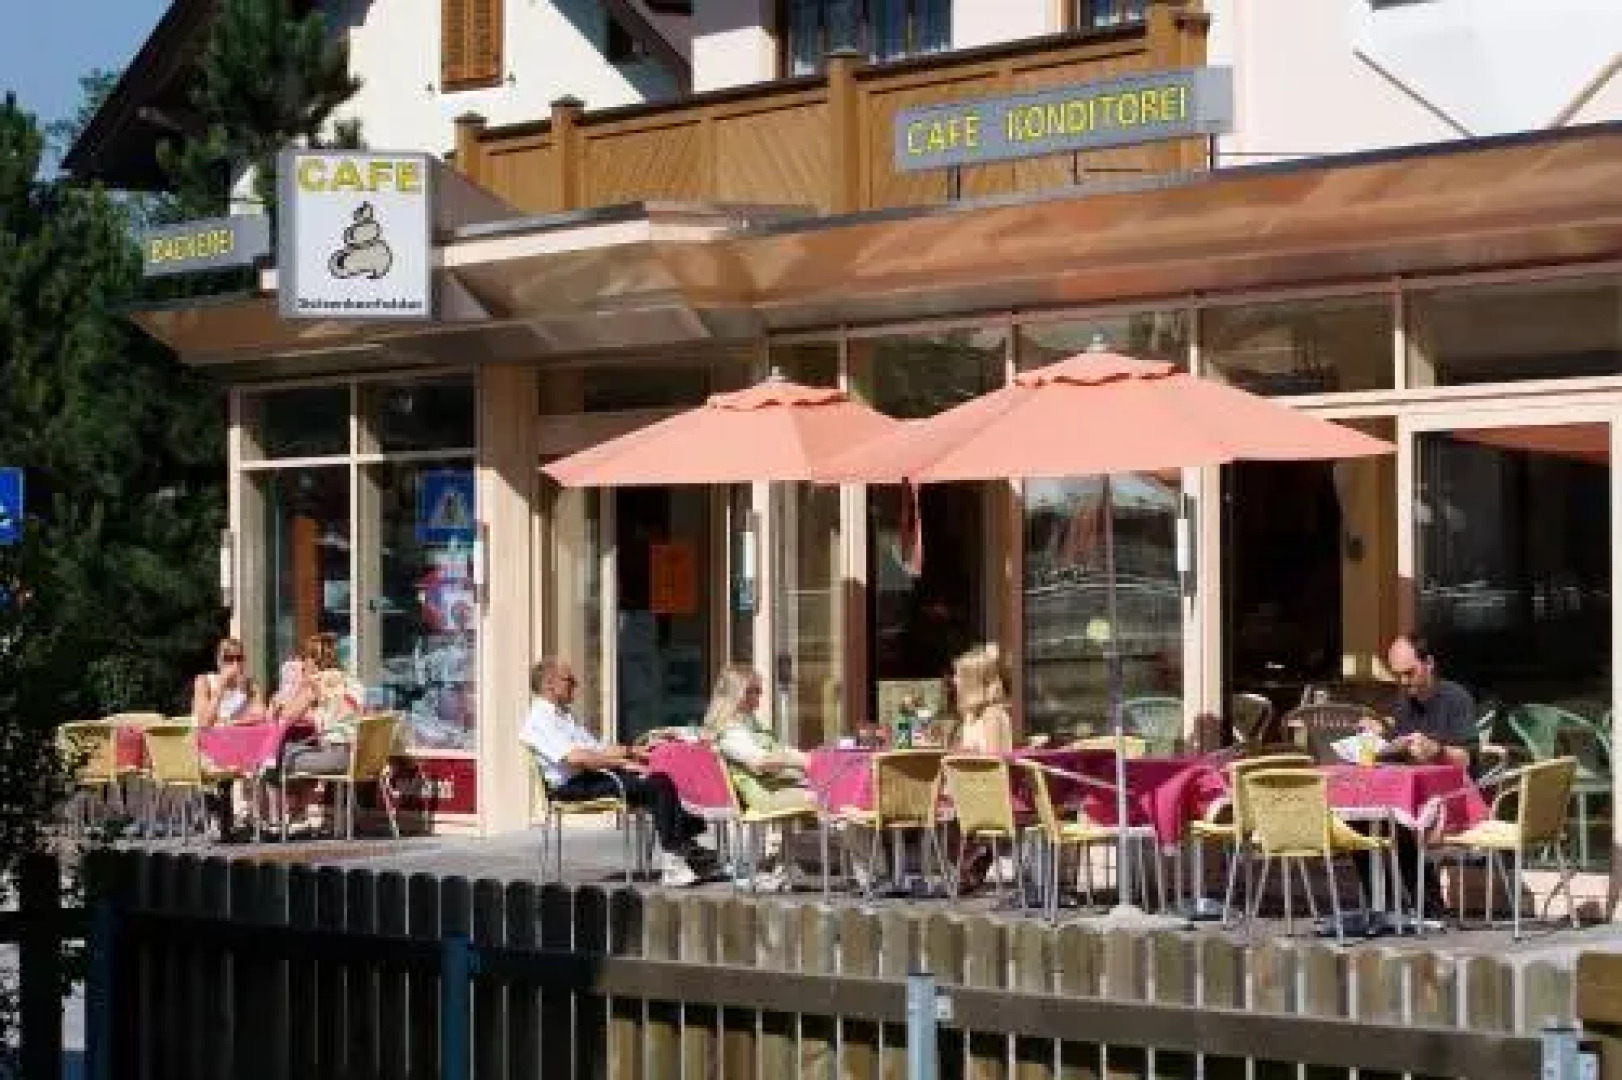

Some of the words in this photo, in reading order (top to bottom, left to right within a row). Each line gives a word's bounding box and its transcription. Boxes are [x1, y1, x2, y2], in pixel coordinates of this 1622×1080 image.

[906, 115, 980, 155] CAFE
[1006, 87, 1186, 141] KONDITOREI
[298, 158, 422, 192] CAFE
